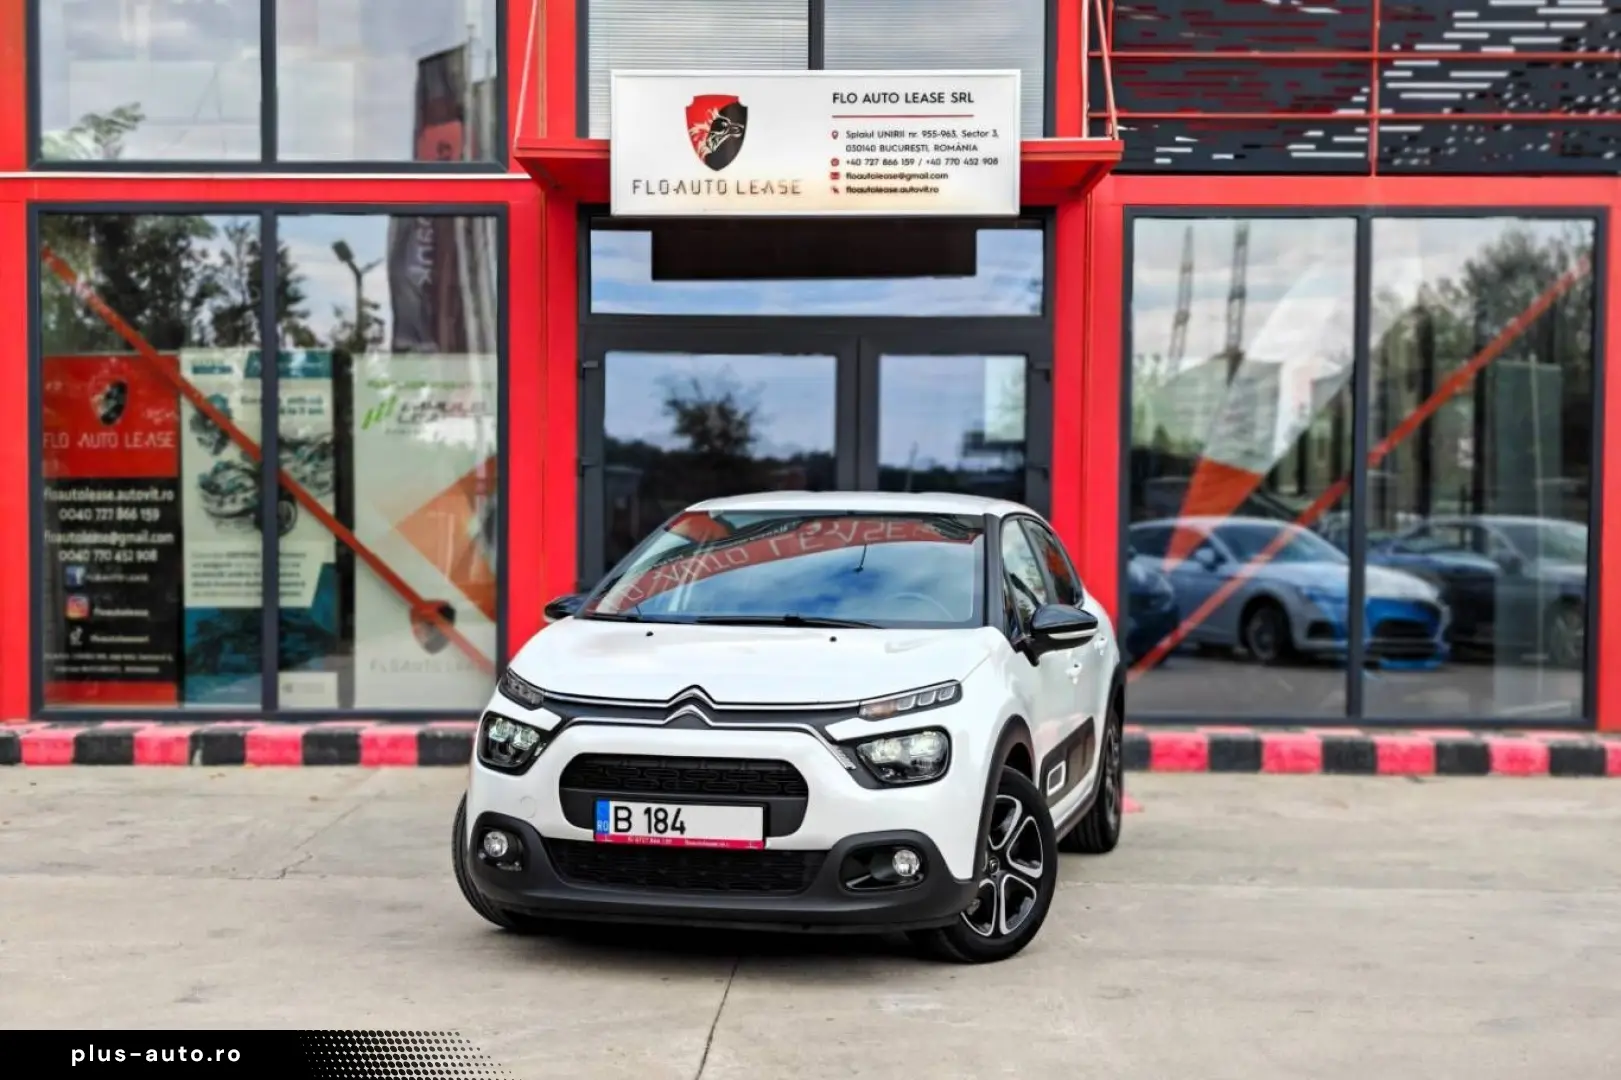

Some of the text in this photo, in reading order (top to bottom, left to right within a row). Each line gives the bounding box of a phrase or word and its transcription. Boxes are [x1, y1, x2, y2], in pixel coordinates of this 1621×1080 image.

[832, 92, 974, 104] FLO AUTO LEASE SRL
[962, 129, 988, 138] Sector
[846, 158, 861, 166] +40
[864, 158, 879, 166] 727
[882, 158, 898, 166] 866
[901, 158, 915, 166] 159
[926, 158, 941, 166] +40
[945, 158, 960, 166] 770
[963, 158, 979, 166] 452
[736, 179, 802, 195] LEASE
[78, 432, 118, 449] AUTO
[124, 431, 176, 449] LEASE
[613, 805, 686, 836] B 184
